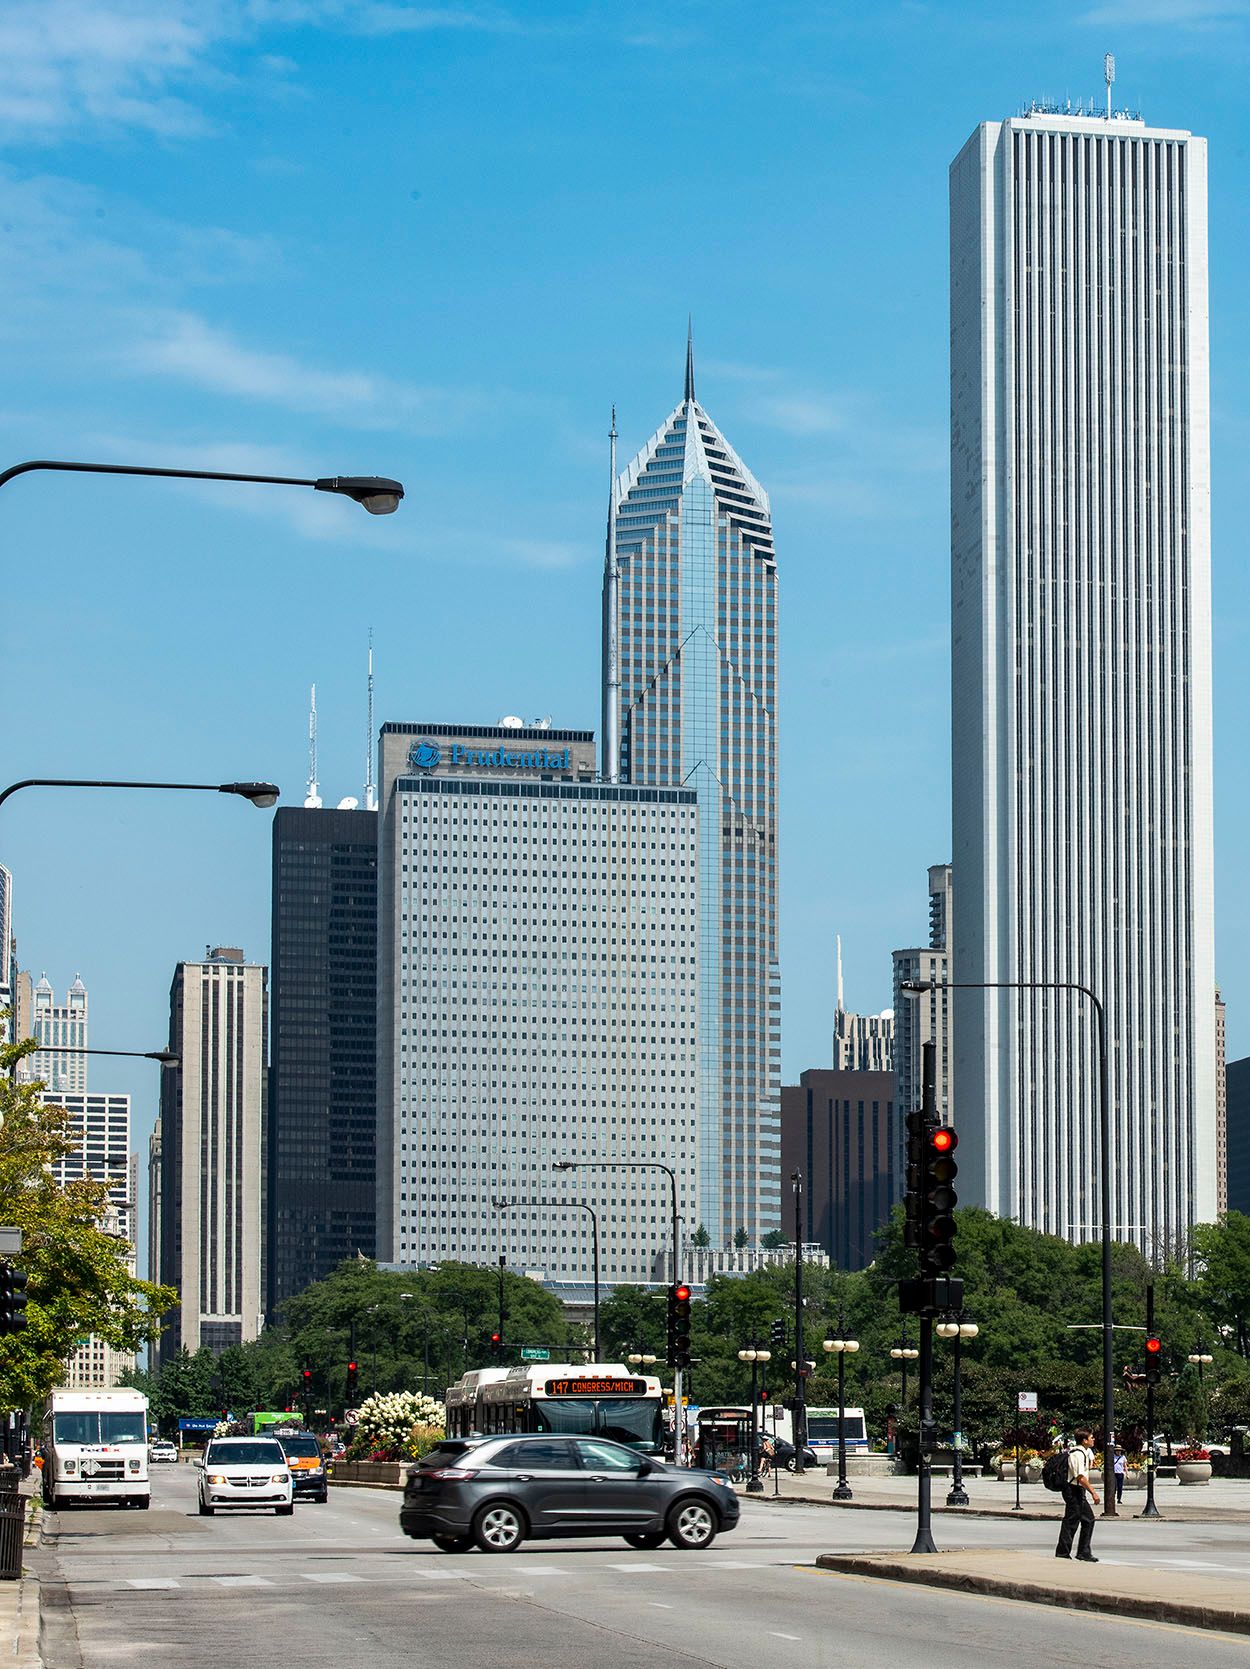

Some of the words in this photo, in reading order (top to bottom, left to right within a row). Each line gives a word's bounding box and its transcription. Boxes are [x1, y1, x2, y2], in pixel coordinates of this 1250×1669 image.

[451, 743, 570, 769] Prudential
[552, 1381, 569, 1395] 147
[571, 1381, 634, 1393] CONGRESS/MICH
